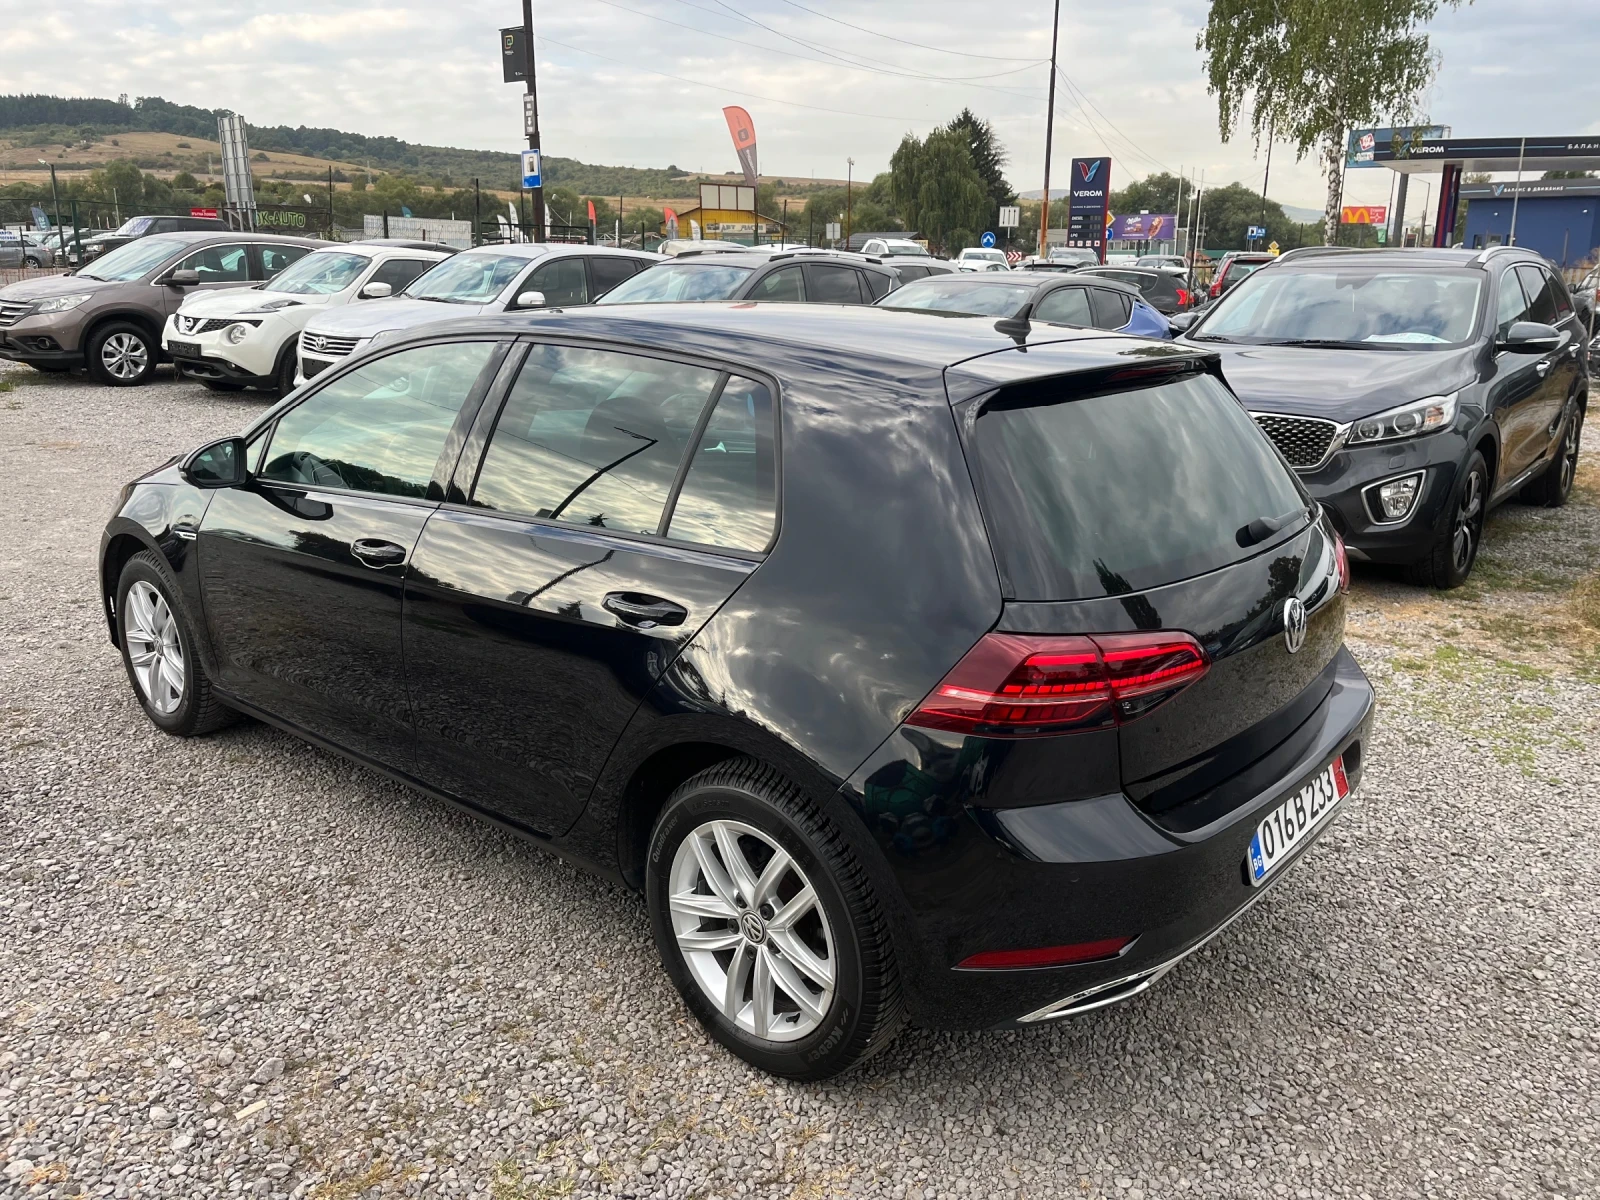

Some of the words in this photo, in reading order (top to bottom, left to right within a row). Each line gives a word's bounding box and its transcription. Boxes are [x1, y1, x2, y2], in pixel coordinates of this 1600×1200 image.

[1409, 145, 1445, 154] VEROM
[1252, 855, 1263, 870] BG
[807, 1025, 844, 1063] Kleber
